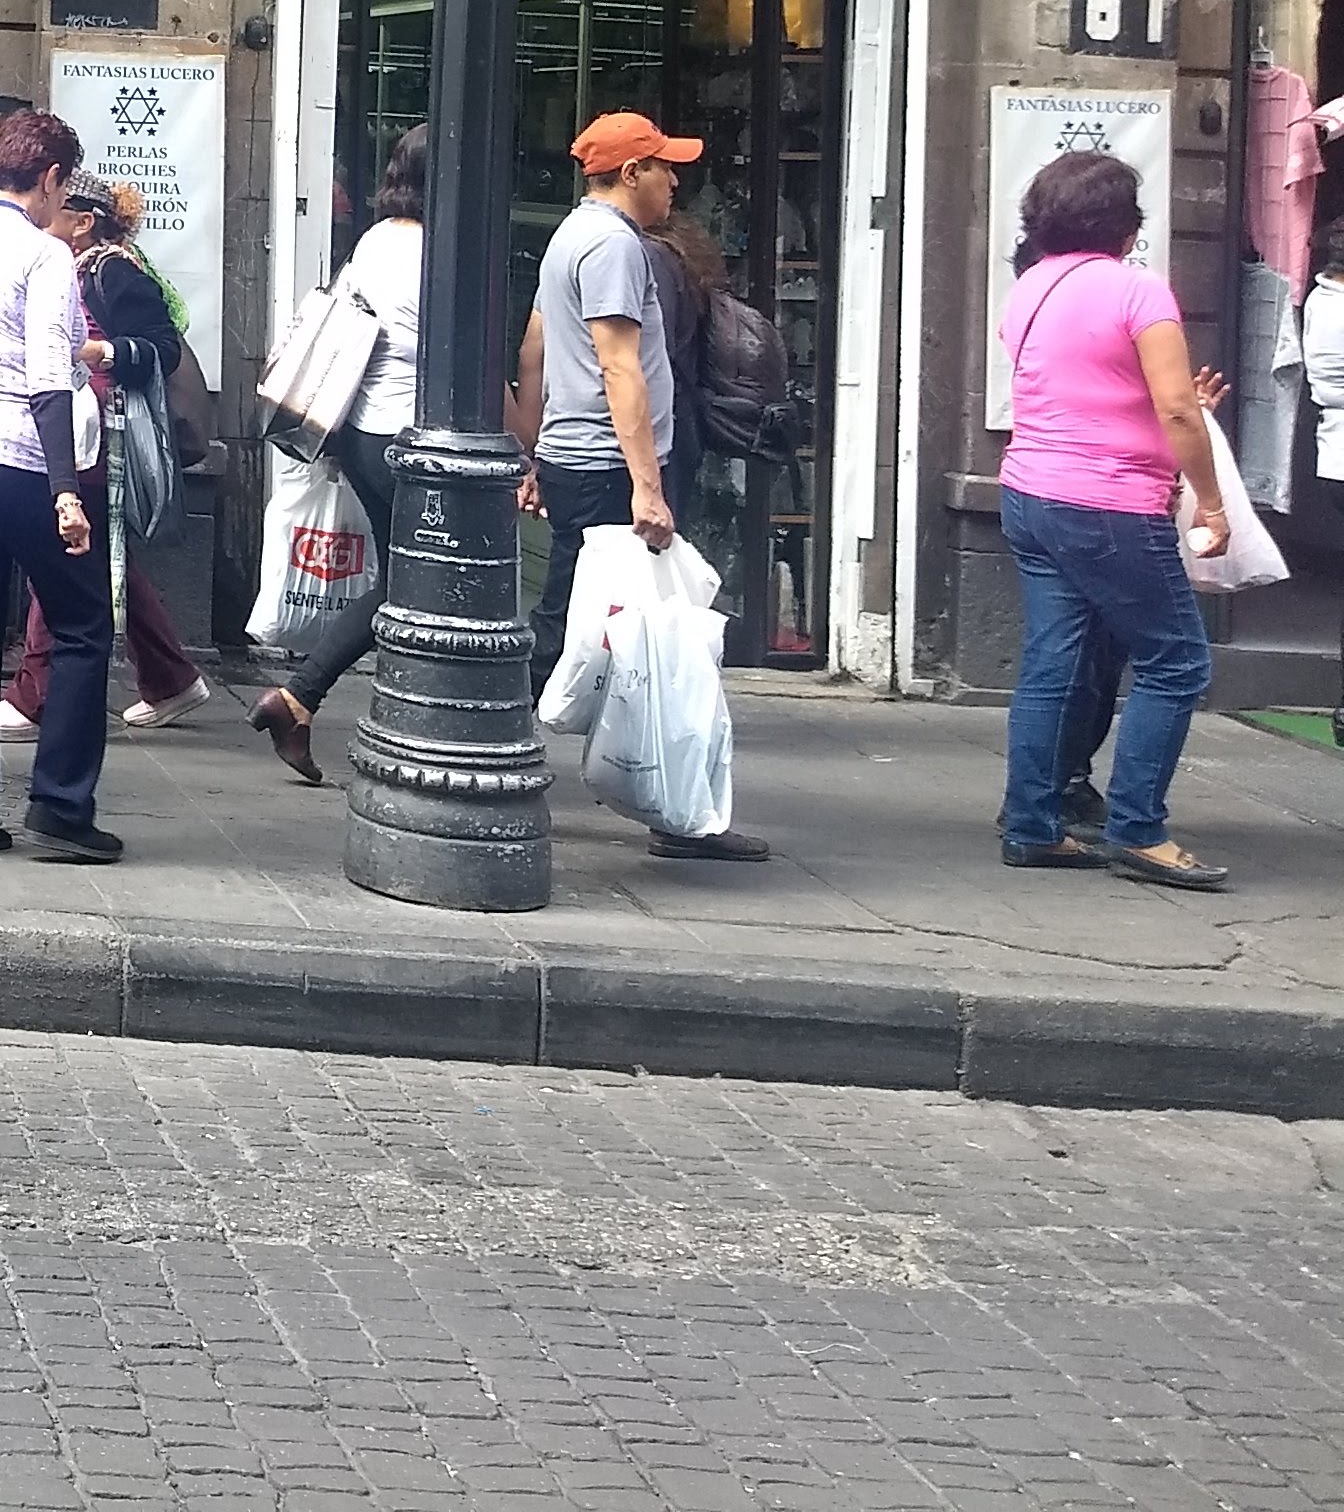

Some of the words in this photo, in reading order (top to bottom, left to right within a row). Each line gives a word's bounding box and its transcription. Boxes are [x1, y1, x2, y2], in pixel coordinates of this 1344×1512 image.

[63, 64, 147, 80] FANTASIAS
[151, 67, 215, 81] LUCERO
[1007, 98, 1092, 113] FANTASIAS
[1096, 101, 1161, 115] LUCERO
[107, 145, 168, 159] PERLAS
[98, 162, 177, 178] BROCHES
[105, 181, 181, 196] QUIRA
